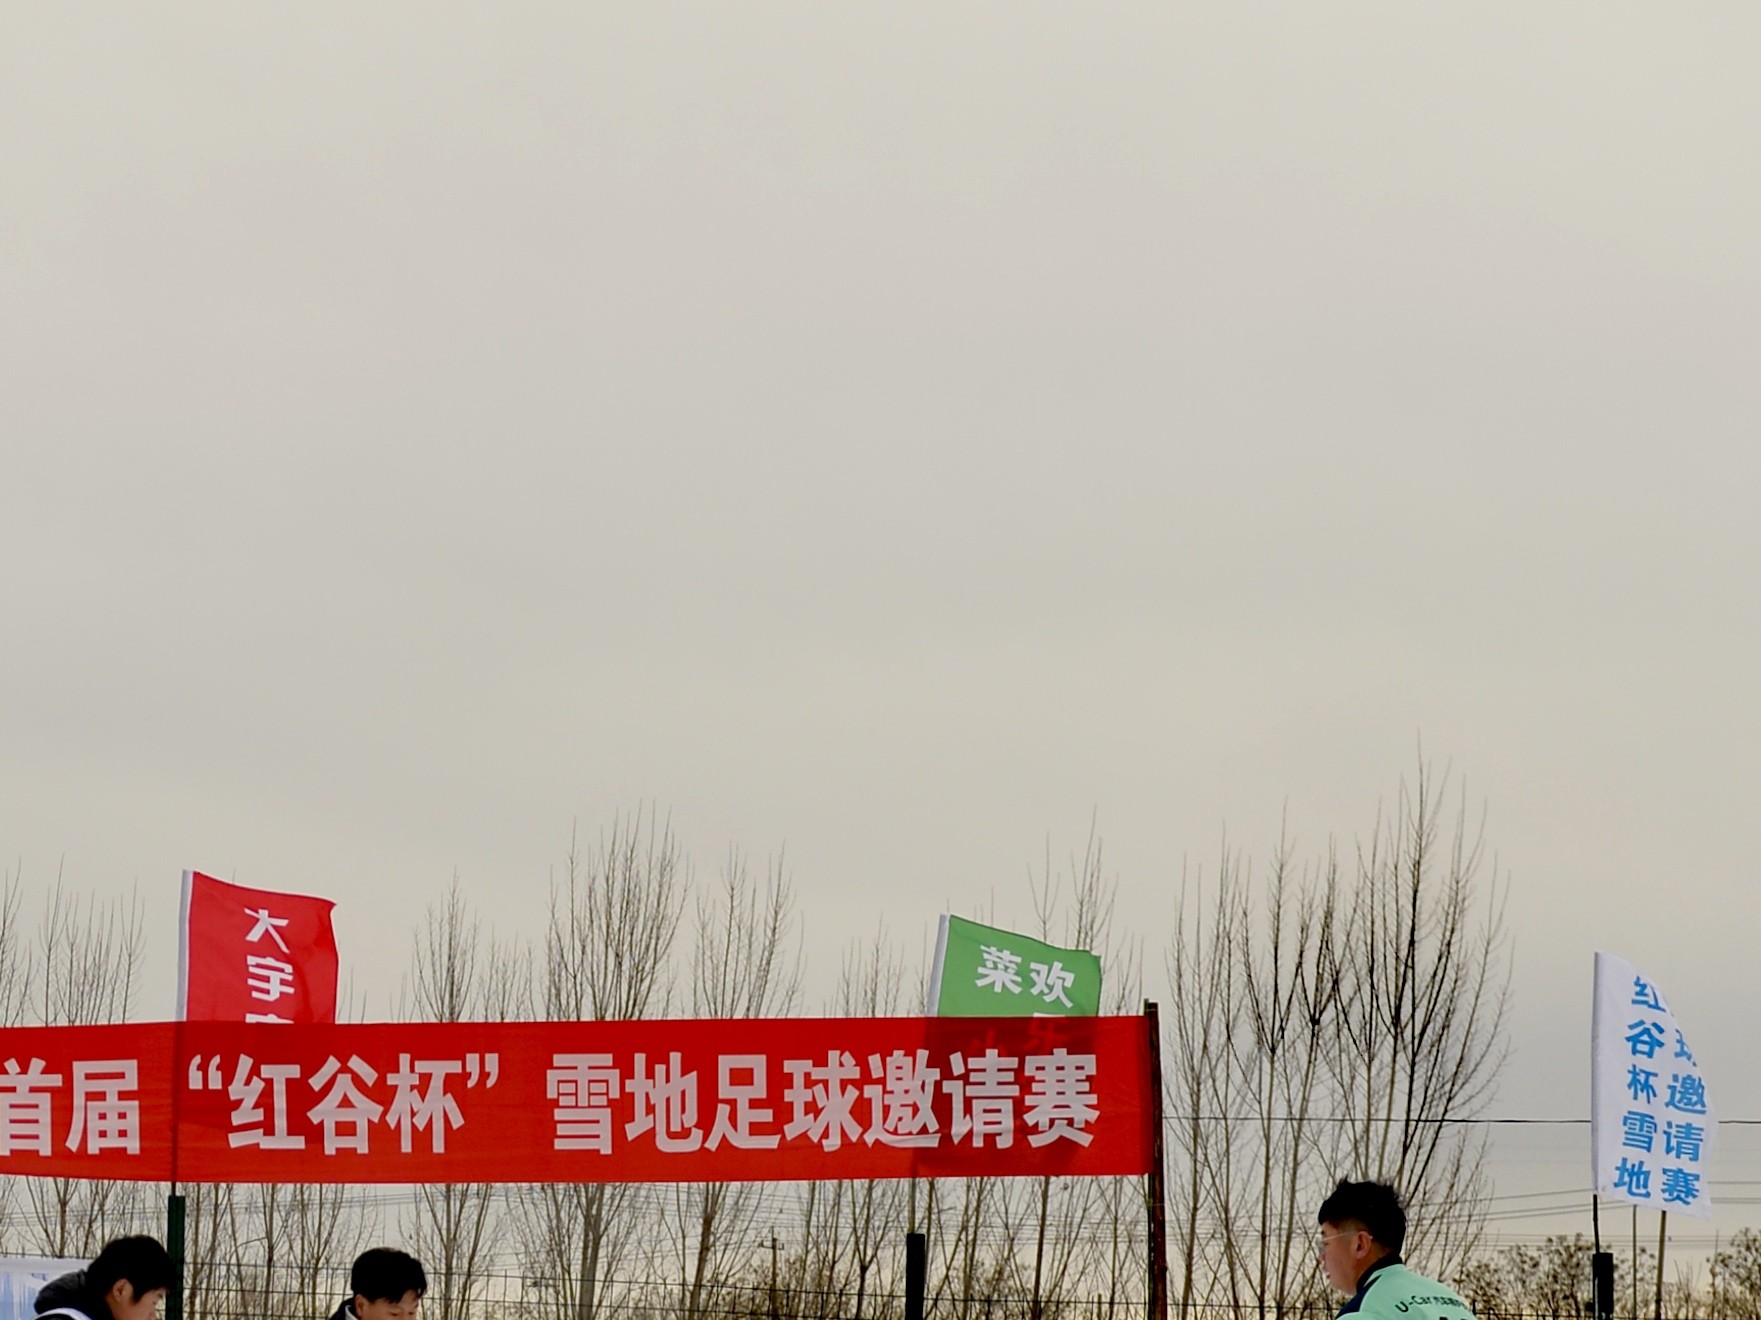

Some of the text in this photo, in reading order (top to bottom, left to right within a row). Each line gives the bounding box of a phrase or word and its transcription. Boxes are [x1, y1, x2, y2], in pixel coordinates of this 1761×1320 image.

[545, 1048, 1102, 1156] 雪地足球邀请赛
